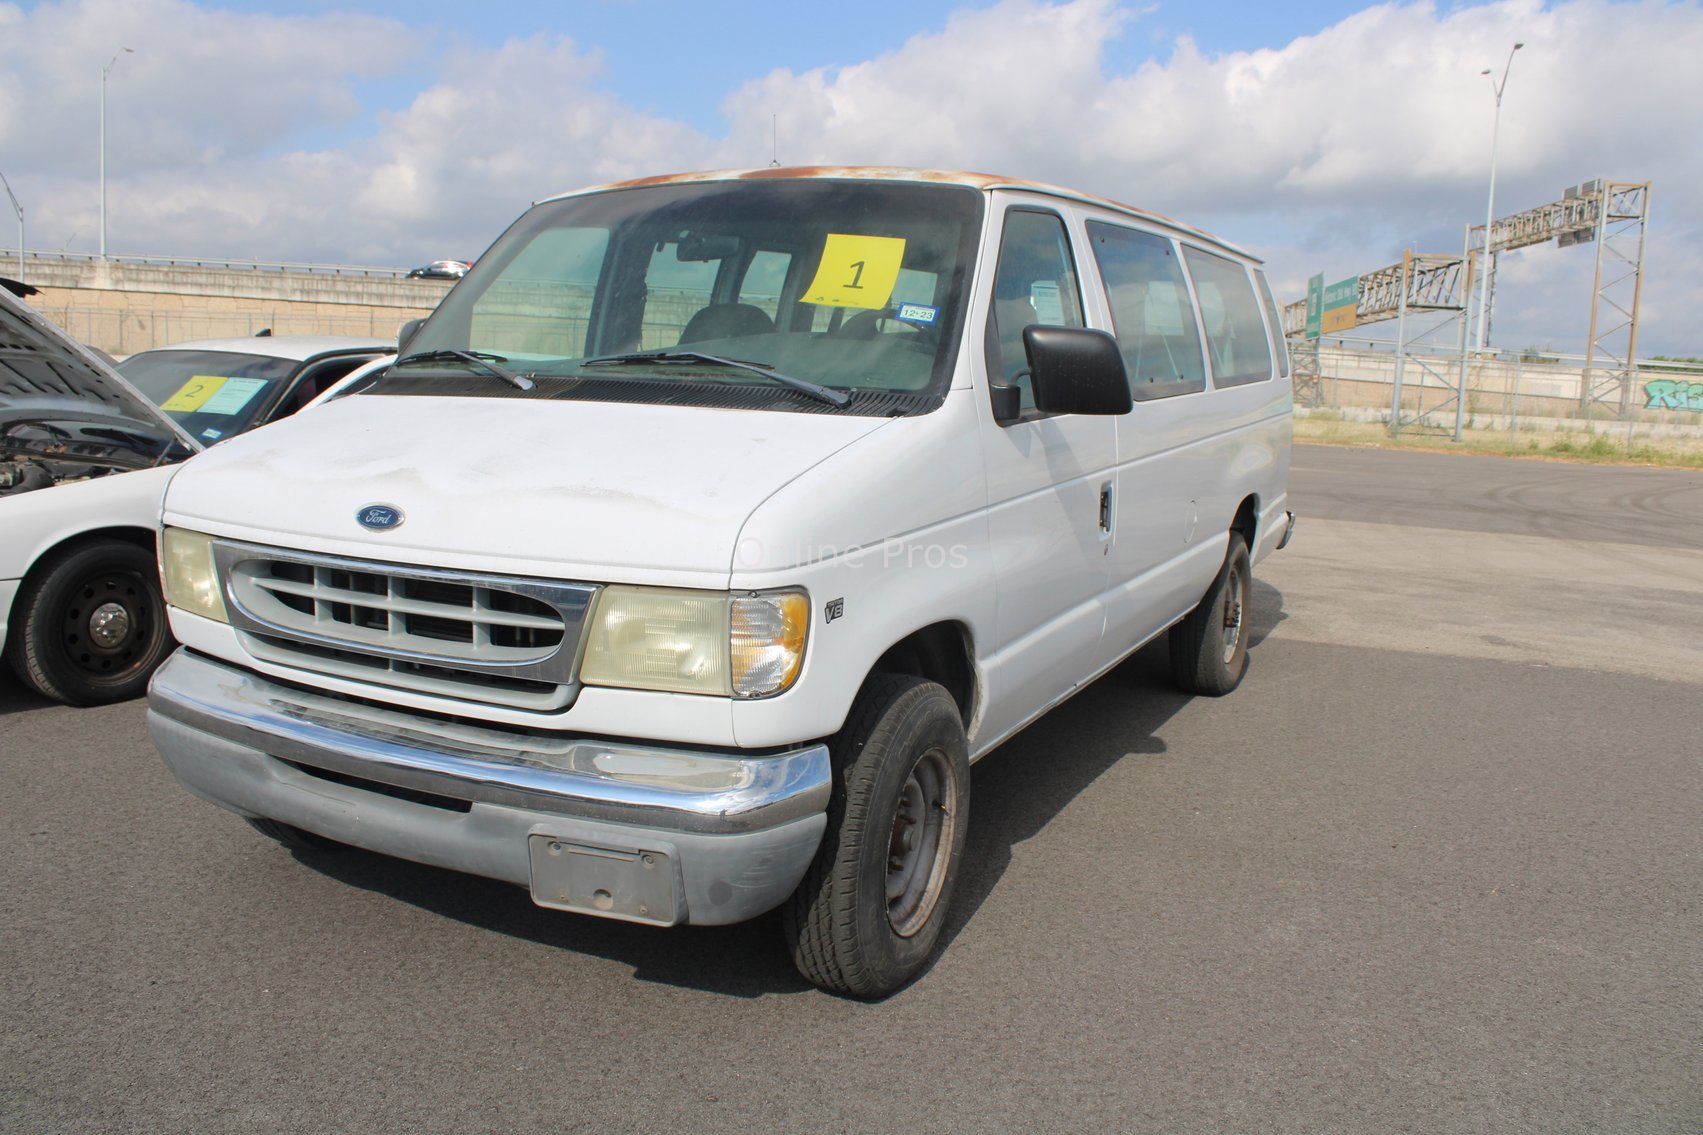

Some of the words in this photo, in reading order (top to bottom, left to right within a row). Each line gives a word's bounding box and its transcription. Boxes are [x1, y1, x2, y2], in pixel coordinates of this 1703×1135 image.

[843, 260, 864, 289] 1
[185, 384, 204, 398] 2
[365, 509, 392, 524] Ford
[826, 604, 843, 622] V8
